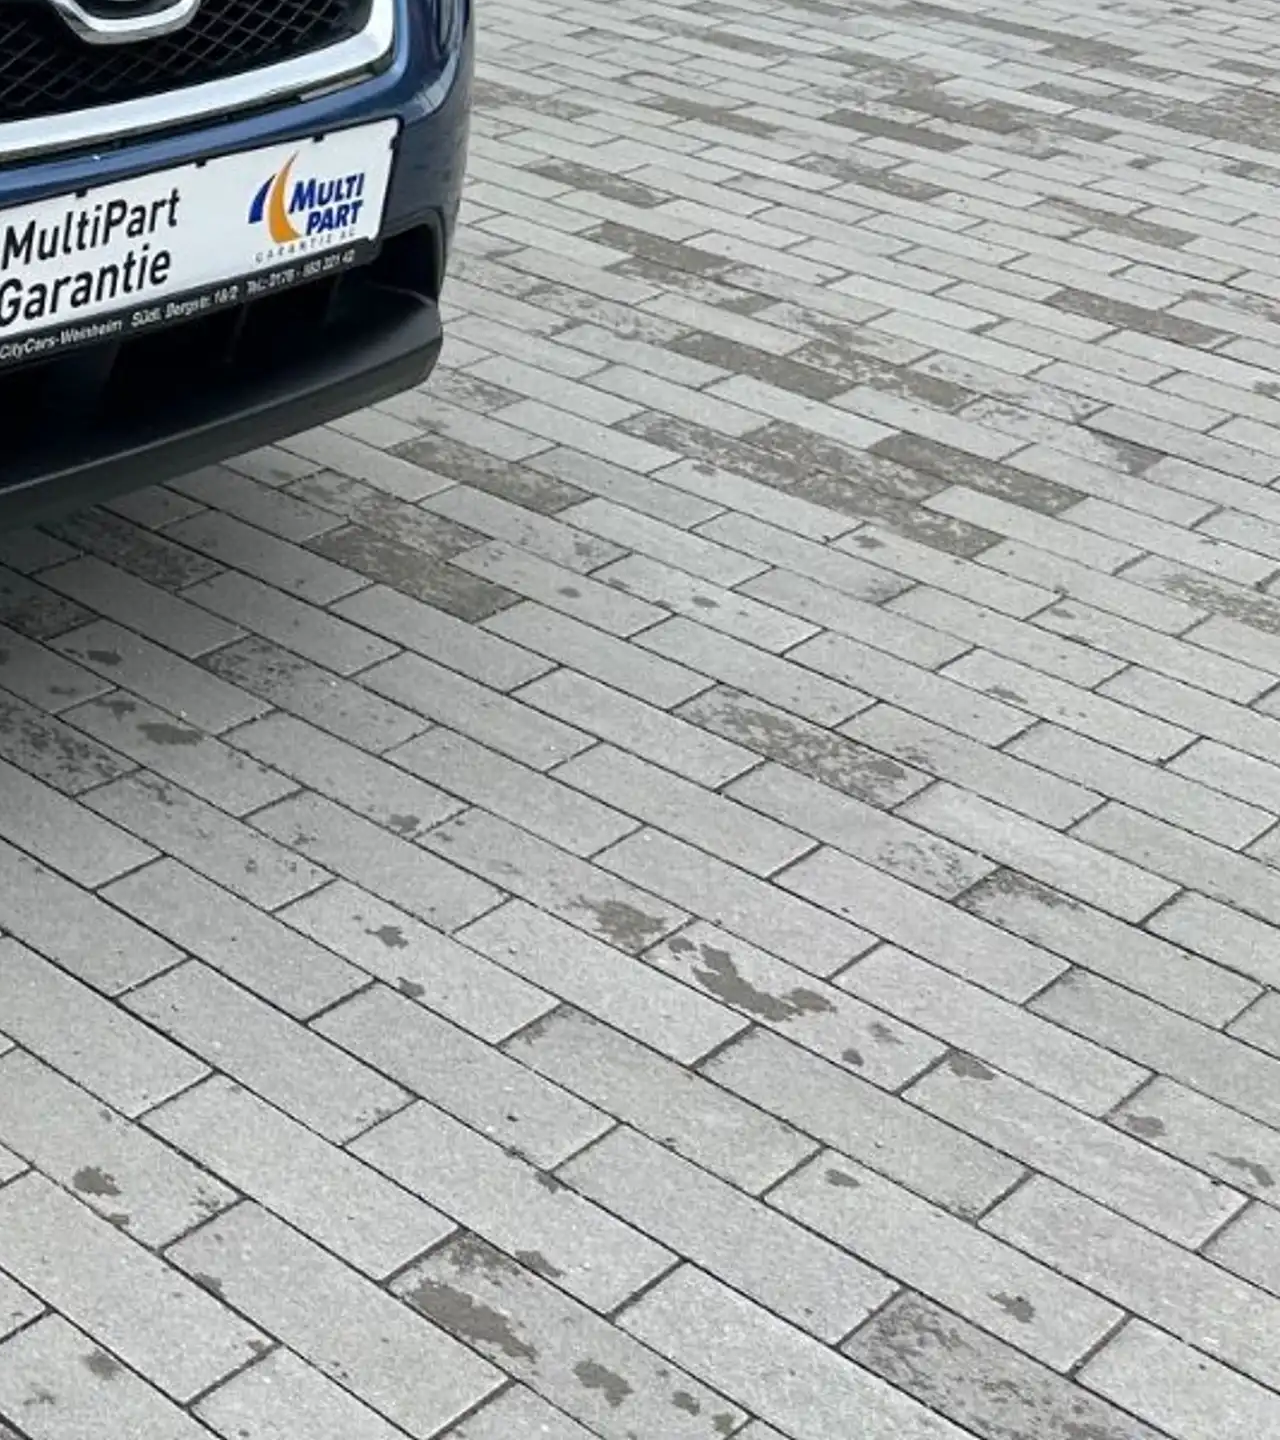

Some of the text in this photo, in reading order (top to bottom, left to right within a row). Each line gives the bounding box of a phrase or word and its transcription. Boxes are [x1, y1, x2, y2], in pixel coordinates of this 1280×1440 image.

[288, 172, 365, 215] MULTI
[1, 187, 181, 270] MultiPart
[306, 199, 364, 237] PART
